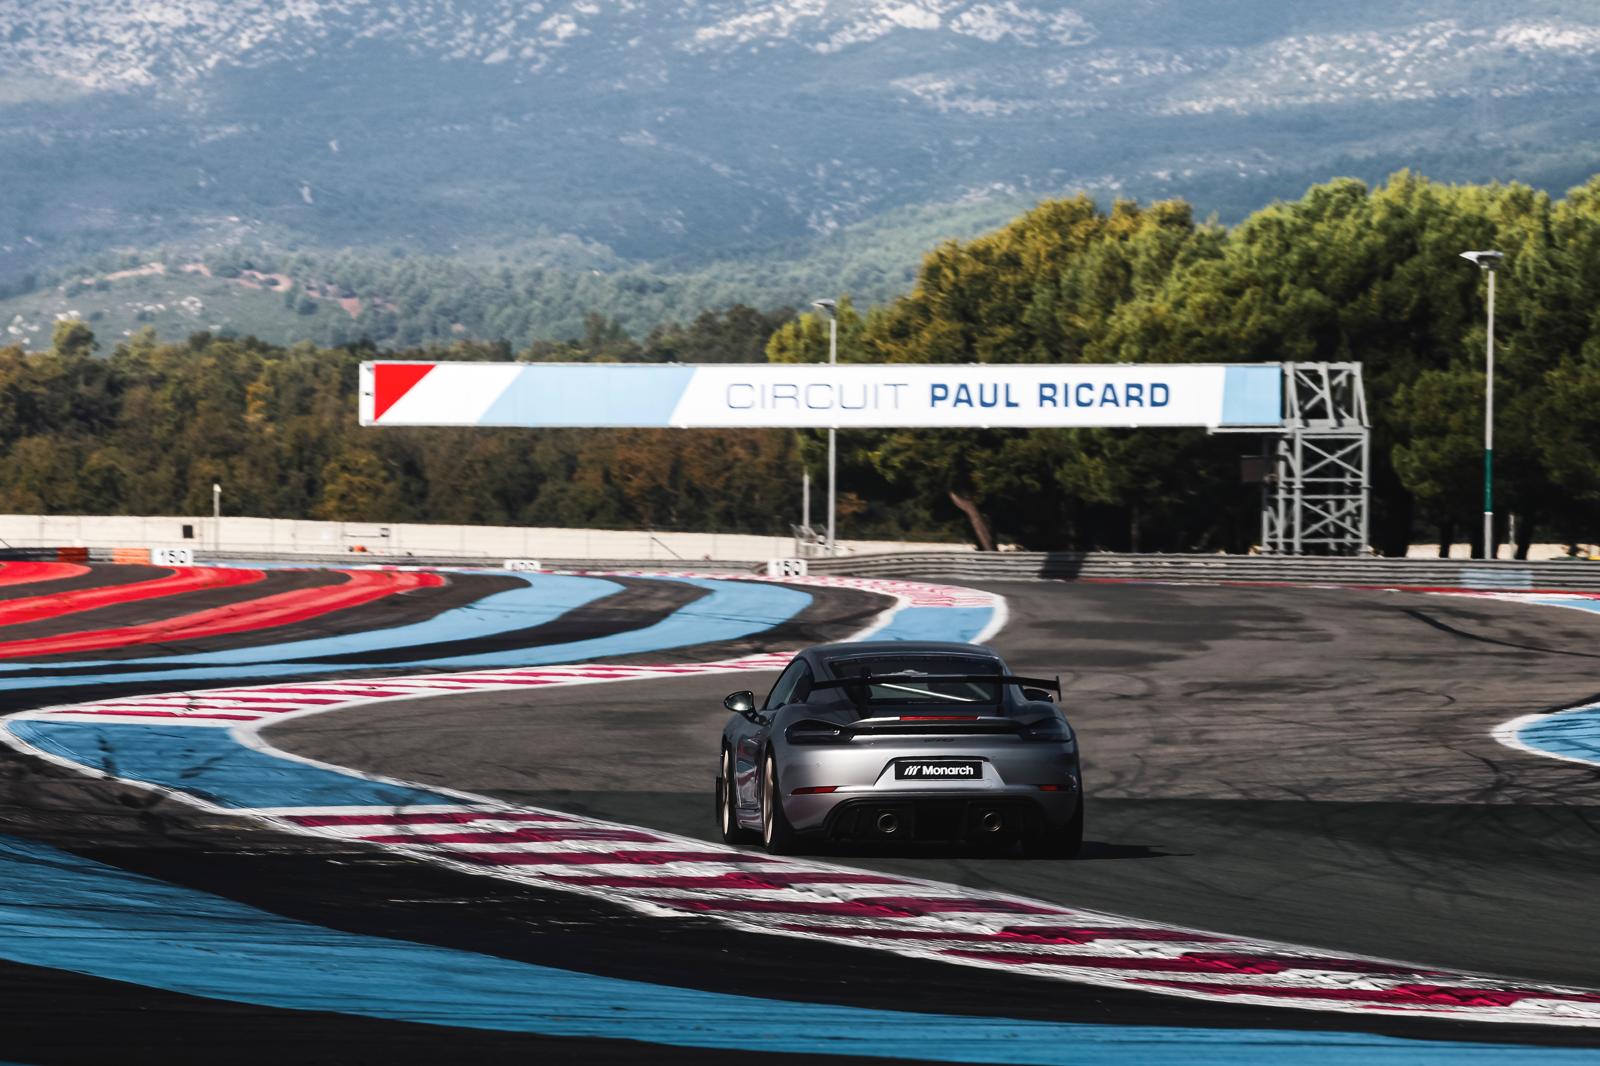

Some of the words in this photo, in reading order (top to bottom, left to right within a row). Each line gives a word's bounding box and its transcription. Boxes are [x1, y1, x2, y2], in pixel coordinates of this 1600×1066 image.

[726, 383, 909, 409] CIRCUIT
[930, 383, 1019, 408] PAUL
[1038, 383, 1170, 408] RICARD
[922, 765, 974, 775] Monarch
